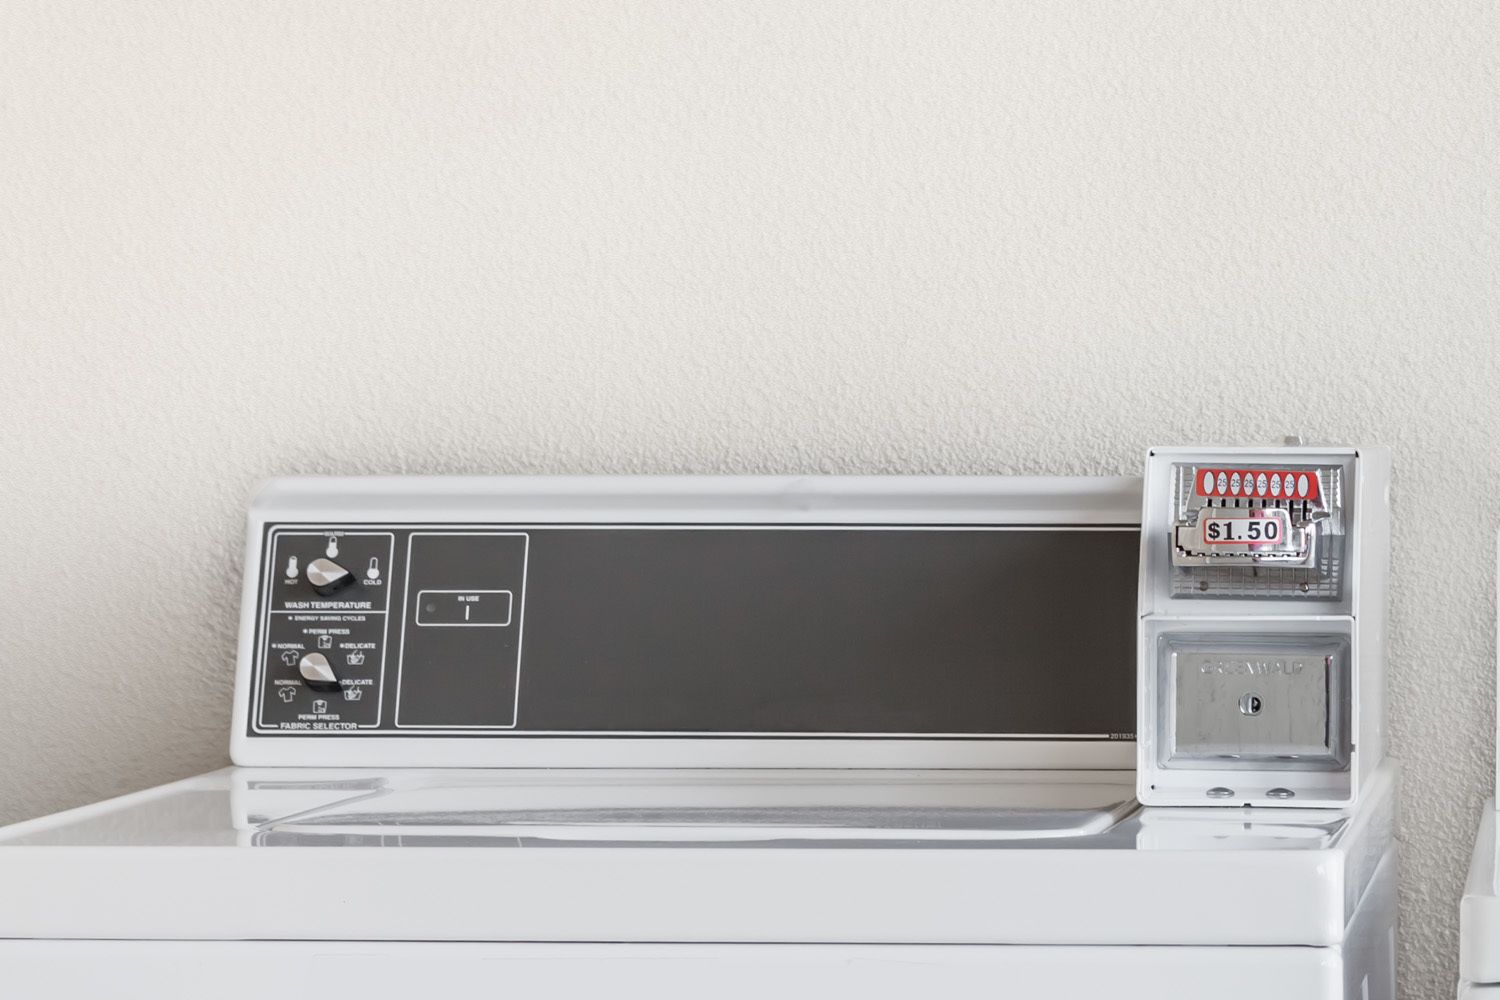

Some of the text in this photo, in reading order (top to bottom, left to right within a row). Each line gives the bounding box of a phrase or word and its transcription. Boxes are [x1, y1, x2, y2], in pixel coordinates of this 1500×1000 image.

[1218, 478, 1294, 488] 25 25 25 25 25 25
[1208, 521, 1278, 540] $1.50
